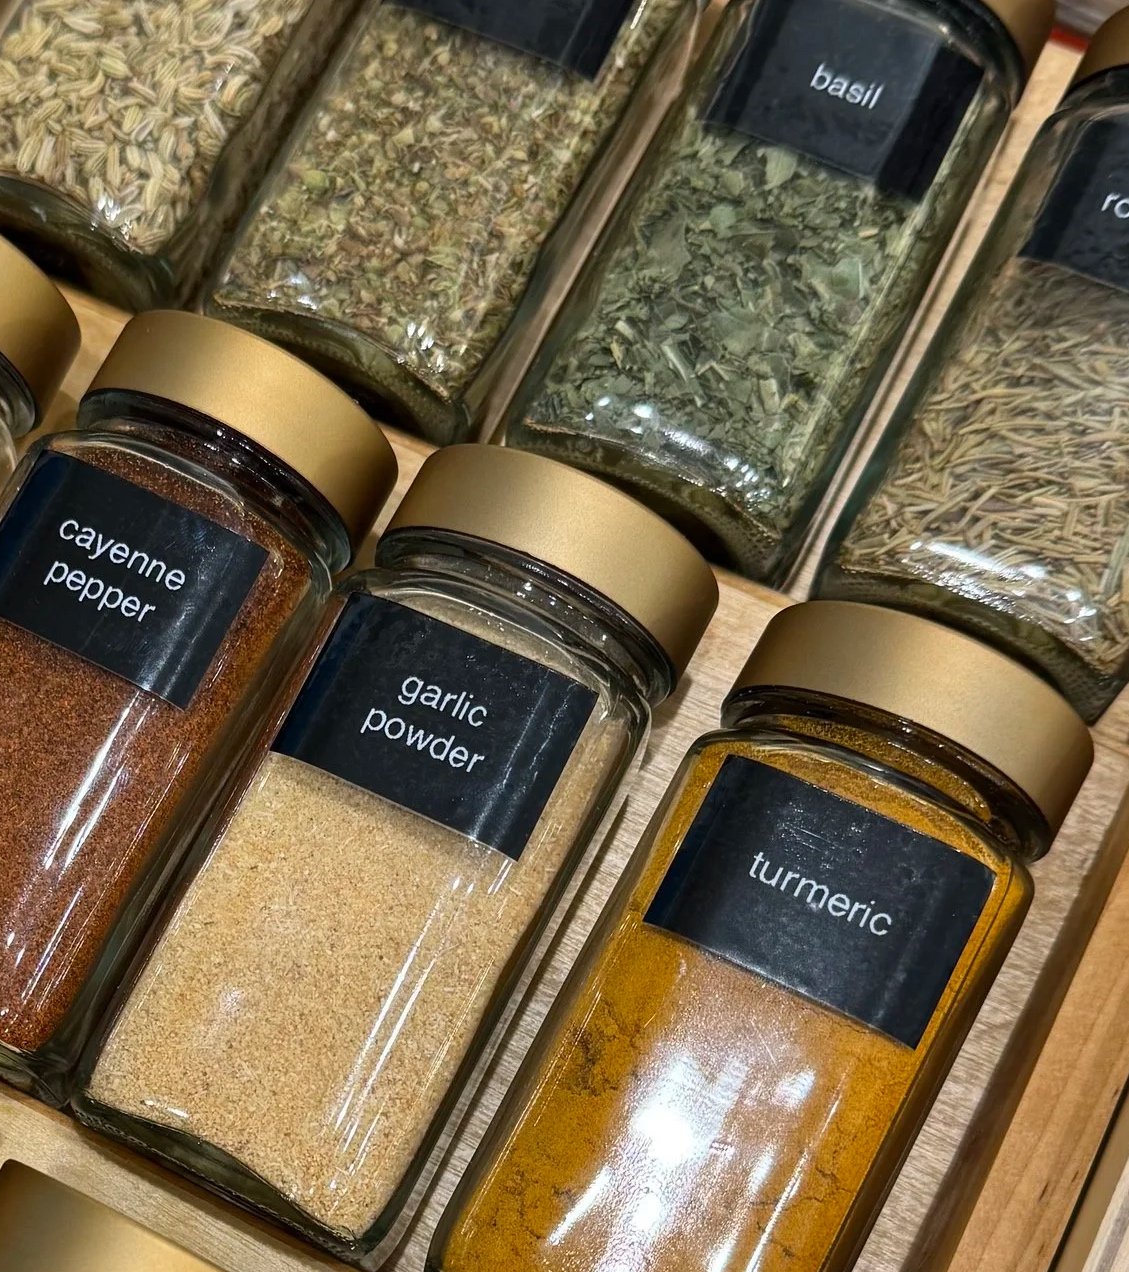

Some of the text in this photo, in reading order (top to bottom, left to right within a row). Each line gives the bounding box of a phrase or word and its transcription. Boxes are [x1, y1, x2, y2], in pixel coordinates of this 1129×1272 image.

[809, 62, 884, 110] basil
[59, 519, 186, 591] cayenne
[42, 556, 157, 623] pepper
[397, 675, 488, 730] garlic
[359, 707, 486, 774] powder
[748, 851, 893, 937] turmeric
